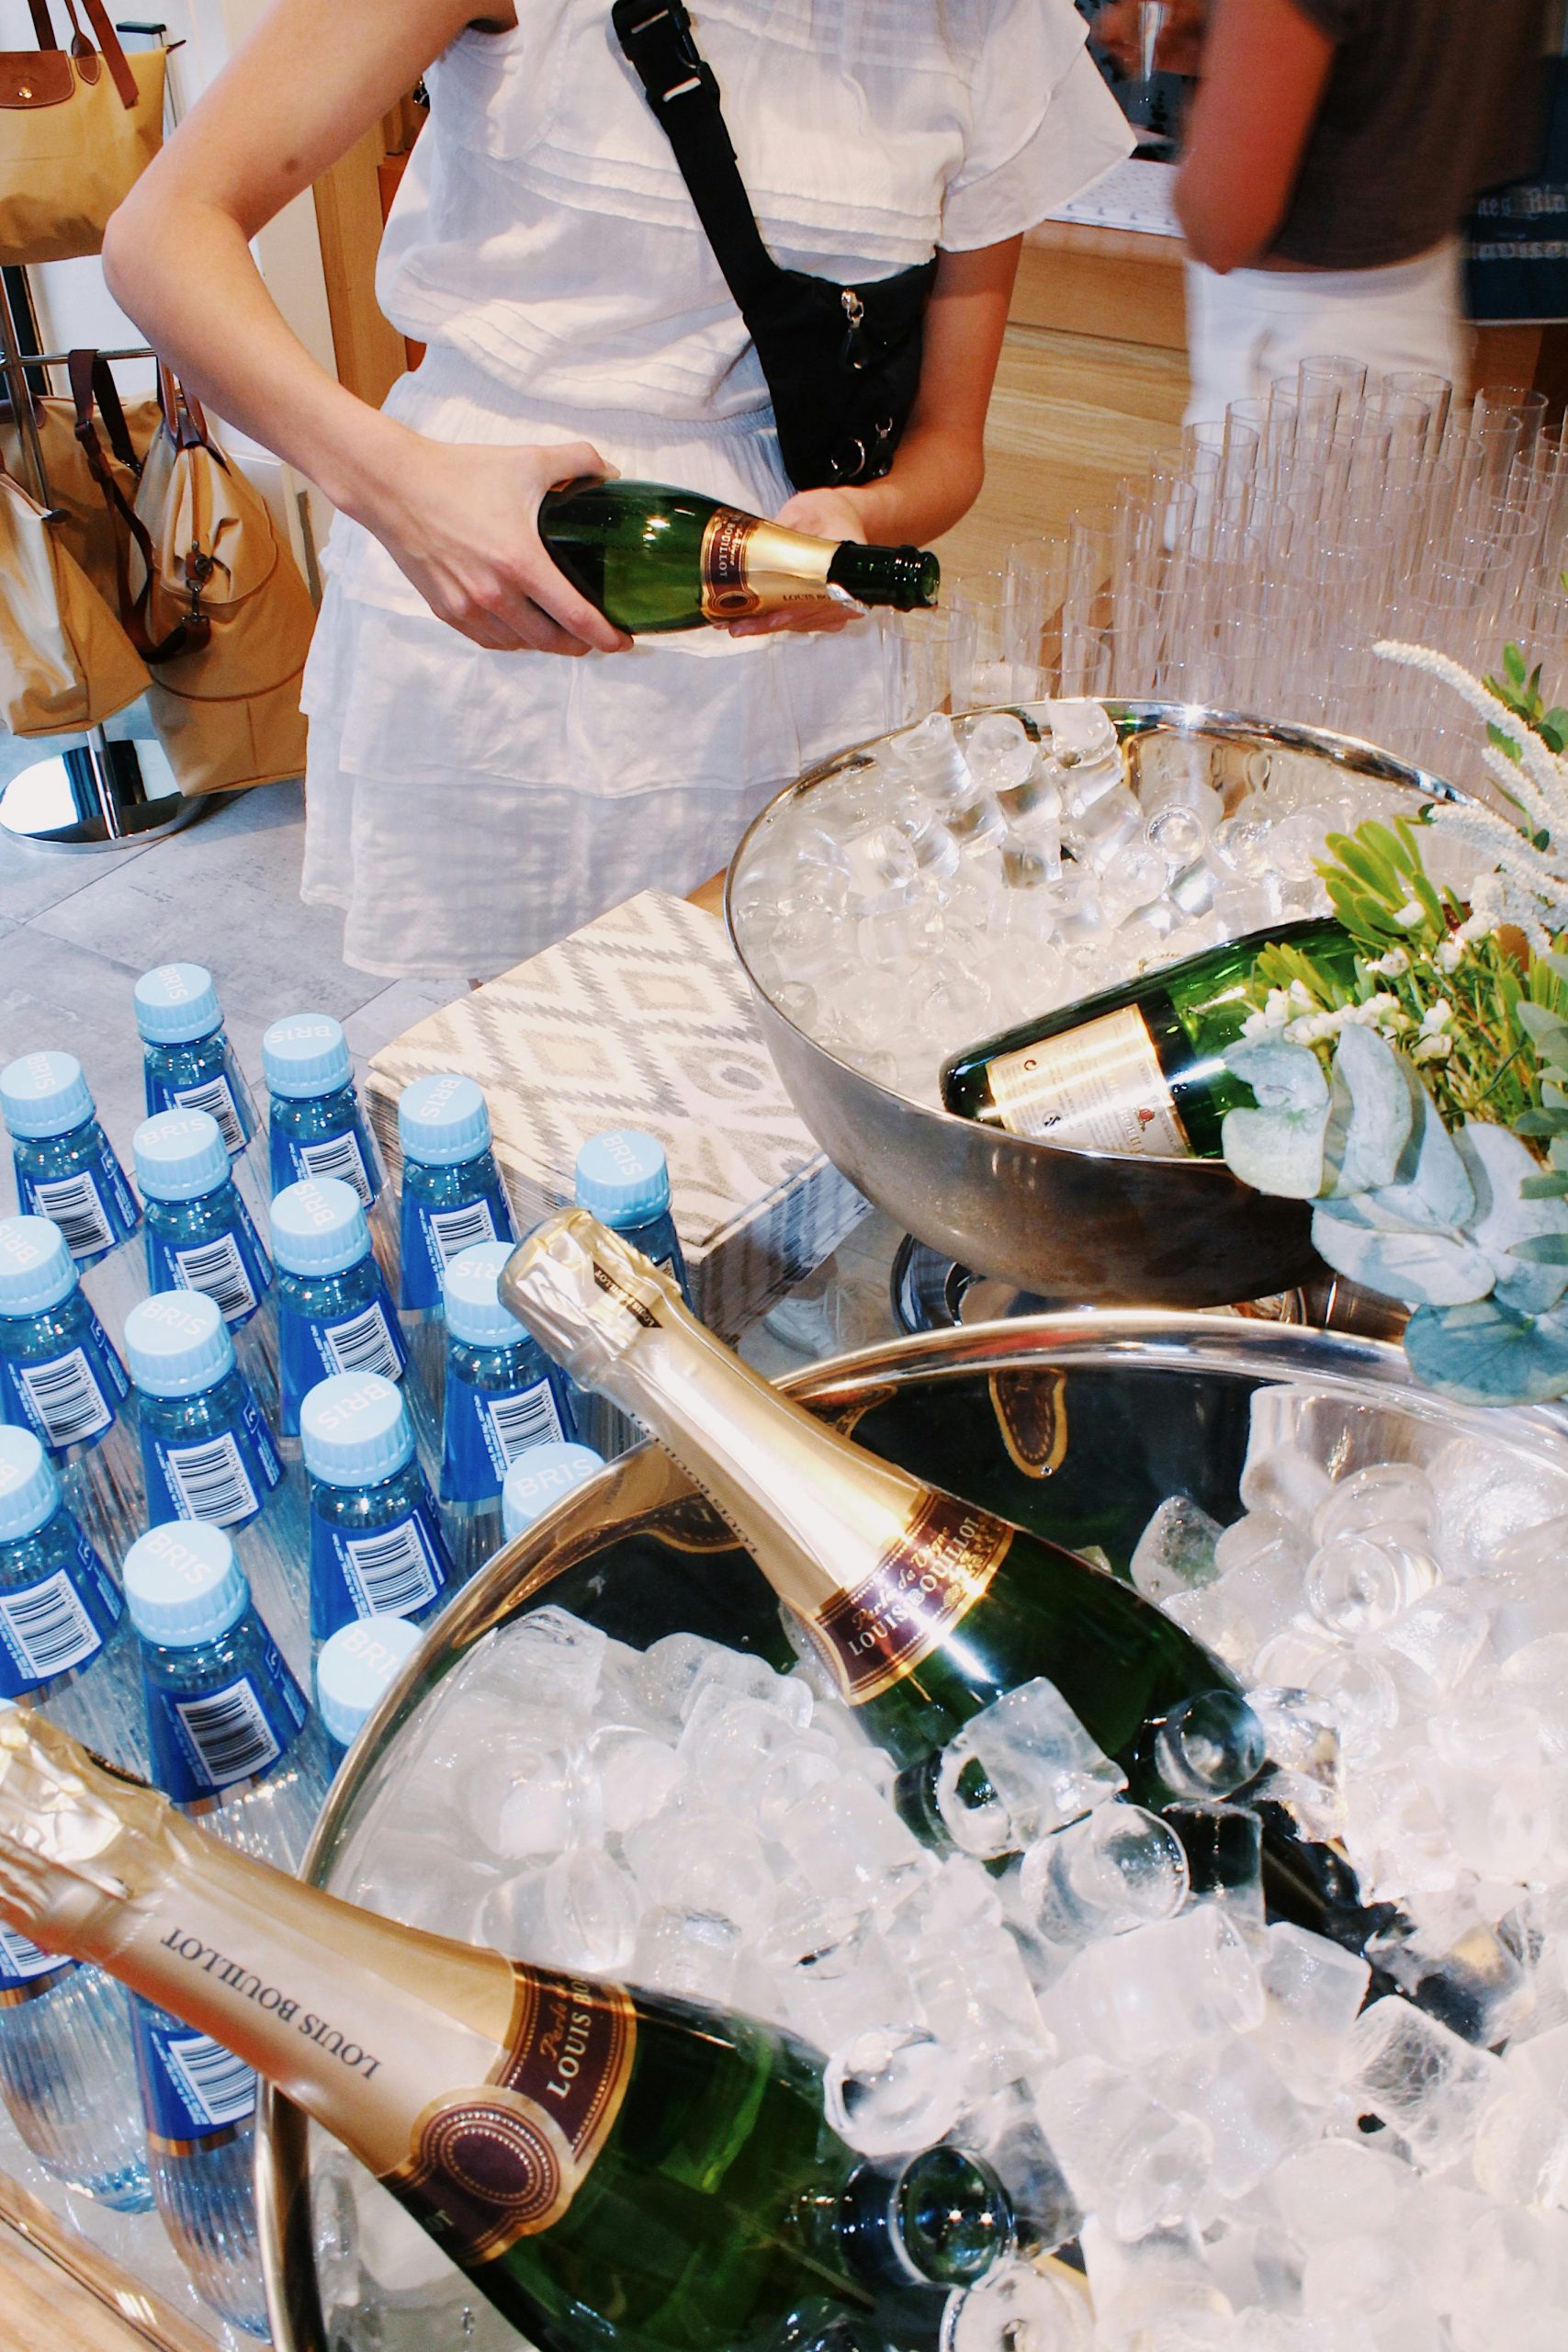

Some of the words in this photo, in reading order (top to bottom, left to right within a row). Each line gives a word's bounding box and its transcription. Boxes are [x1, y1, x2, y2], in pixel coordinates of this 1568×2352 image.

[719, 523, 735, 578] BOUILLOT
[156, 966, 189, 1001] BRIS
[270, 1024, 333, 1044] BRIS
[25, 1054, 57, 1091] BRIS
[419, 1078, 463, 1119] BRIS
[139, 1118, 207, 1147] BRIS
[602, 1133, 645, 1176] BRIS
[294, 1182, 336, 1226] BRIS
[141, 1299, 208, 1336] BRIS
[317, 1383, 390, 1430] BRIS
[512, 1458, 595, 1498] BRIS
[143, 1532, 213, 1585] BRIS
[848, 1605, 908, 1657] LOUIS
[906, 1516, 980, 1608] BOUILLOT
[340, 1628, 399, 1680] BRI
[160, 1927, 300, 2022] BOUILLOT
[299, 2012, 382, 2081] LOUIS
[547, 2011, 592, 2100] LOUIS
